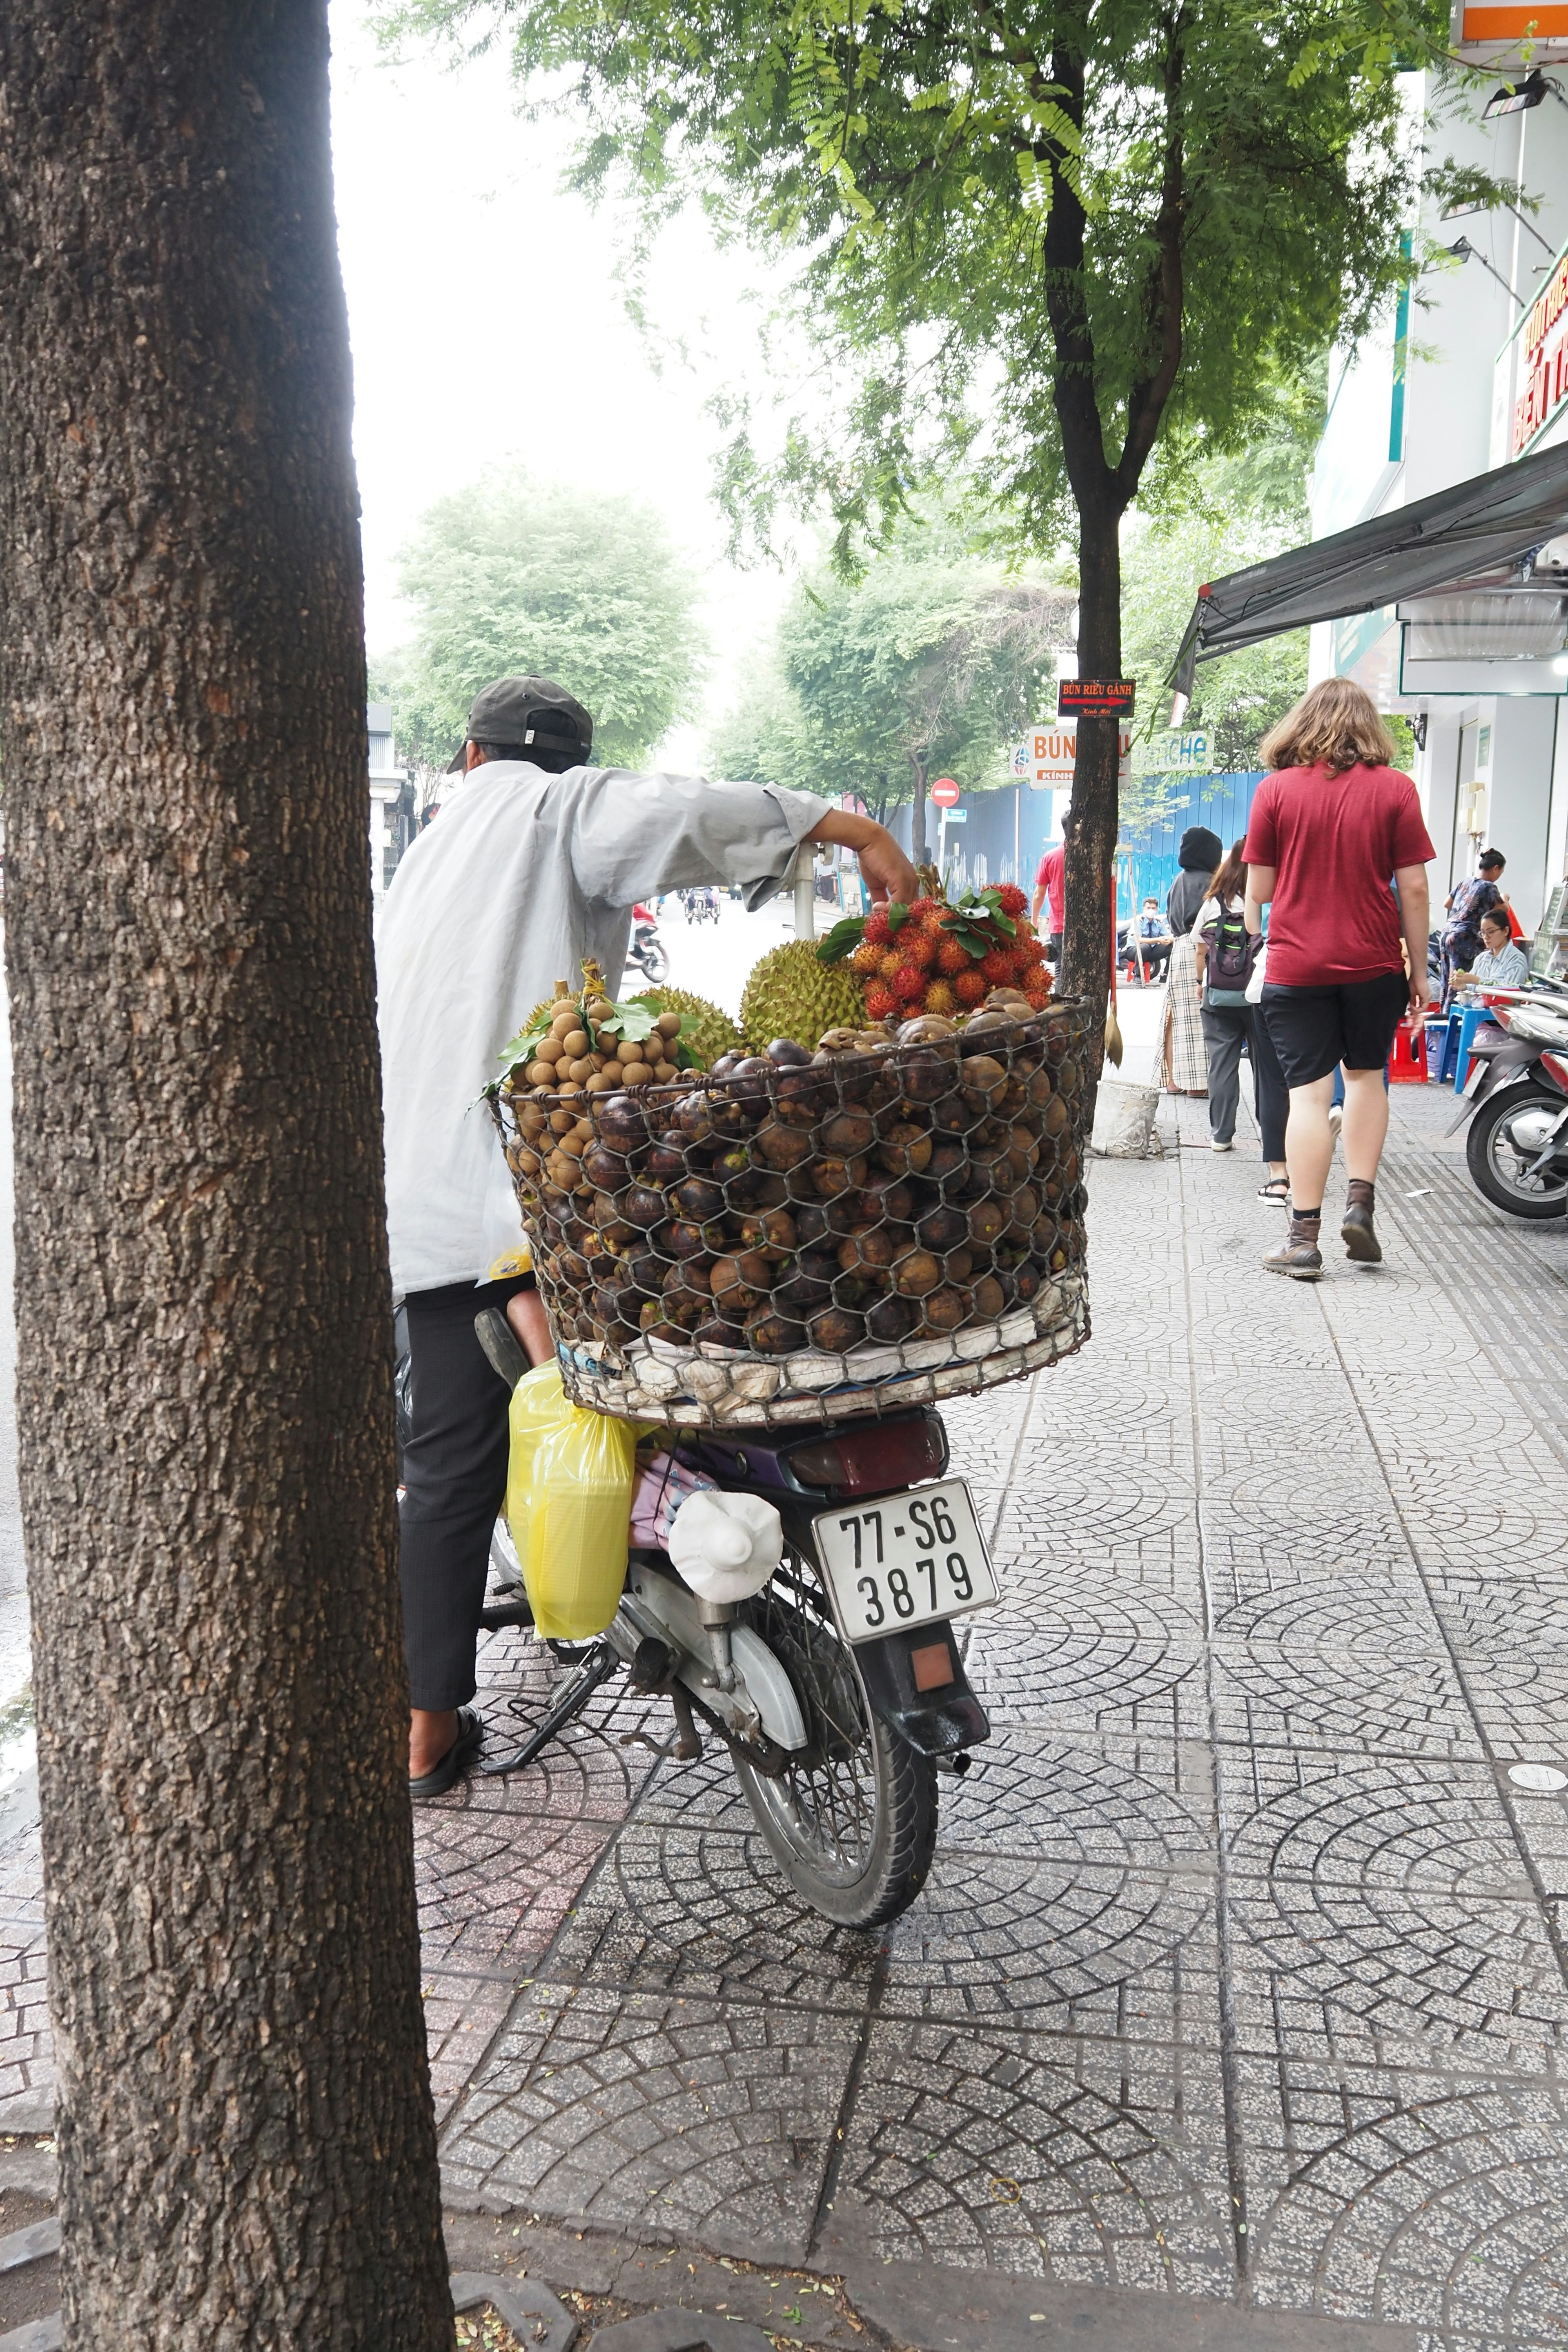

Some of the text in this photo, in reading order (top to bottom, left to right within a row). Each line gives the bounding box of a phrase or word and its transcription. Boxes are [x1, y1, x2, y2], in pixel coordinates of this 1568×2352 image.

[1062, 682, 1081, 695] BÚN
[1107, 682, 1132, 695] GÁNH
[1035, 729, 1076, 759] BÚN
[1042, 771, 1073, 780] KÍNH
[858, 1552, 973, 1627] 3879
